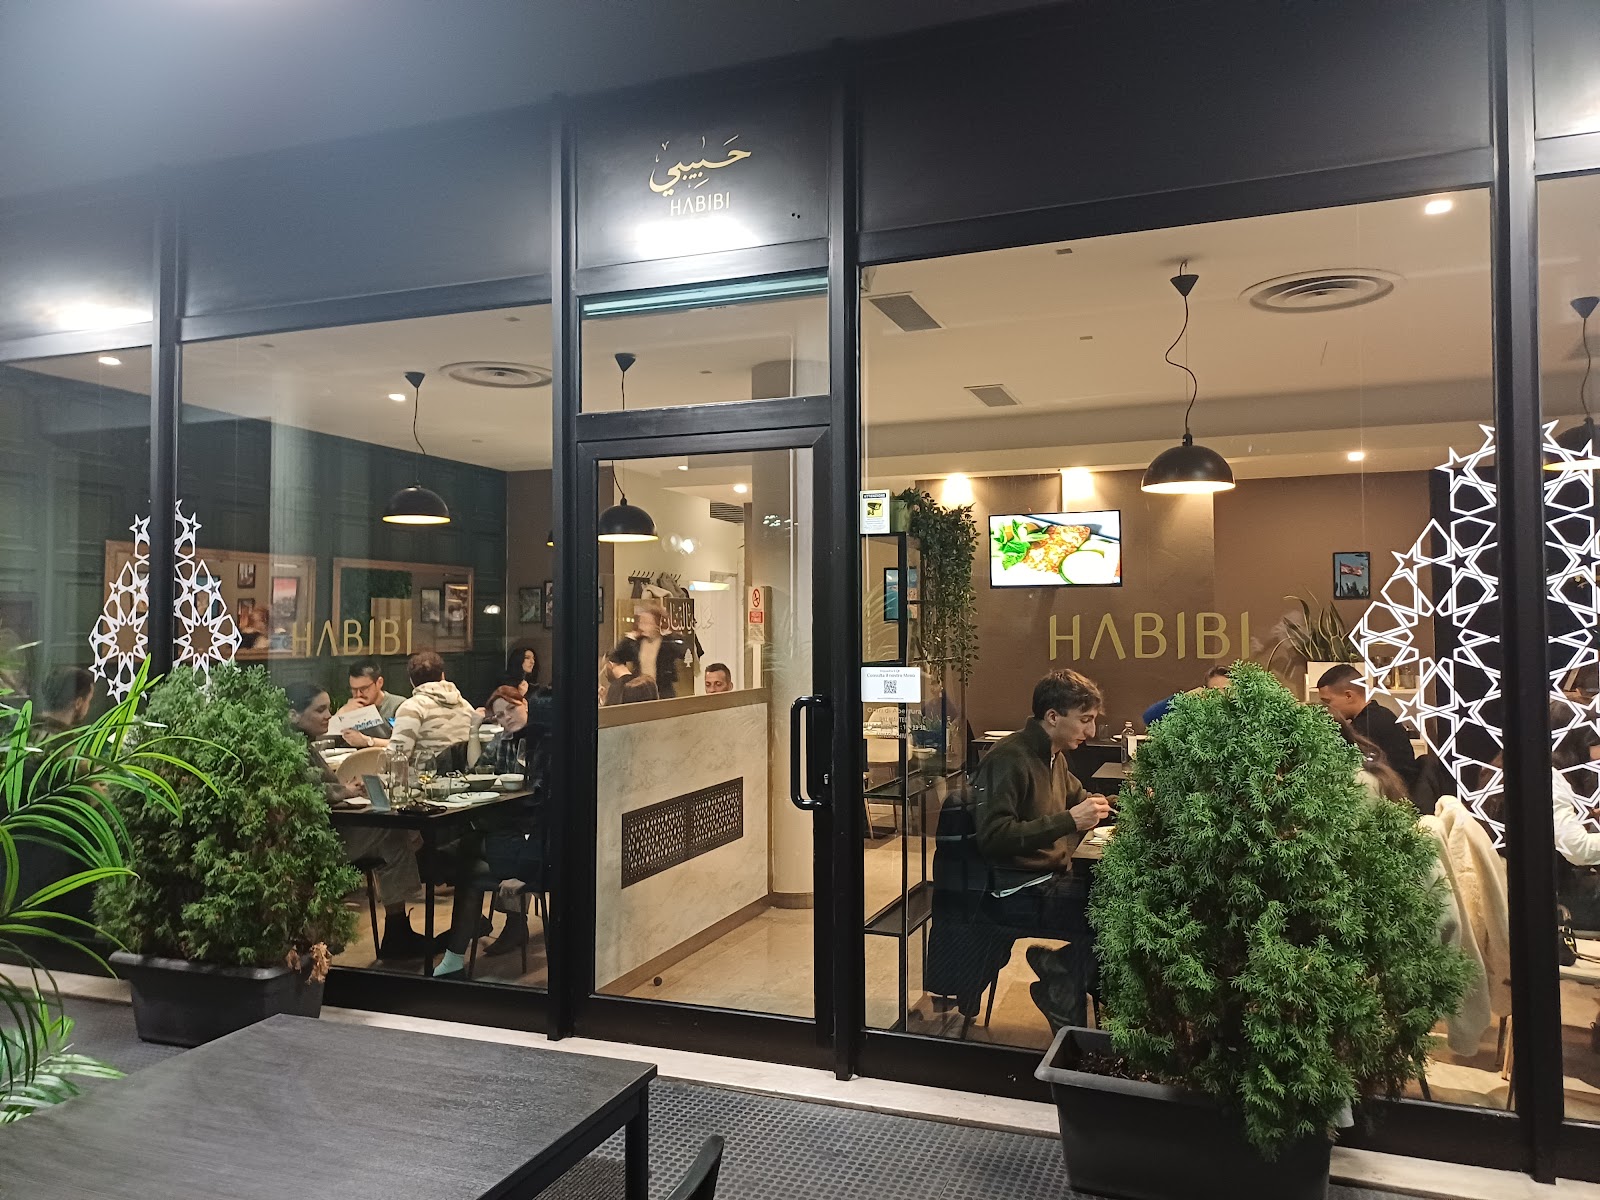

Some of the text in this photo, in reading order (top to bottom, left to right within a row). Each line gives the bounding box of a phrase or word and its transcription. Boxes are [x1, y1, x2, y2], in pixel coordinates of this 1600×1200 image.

[670, 192, 731, 216] HABIBI
[292, 619, 412, 657] HABIBI
[1049, 611, 1250, 661] HABIBI
